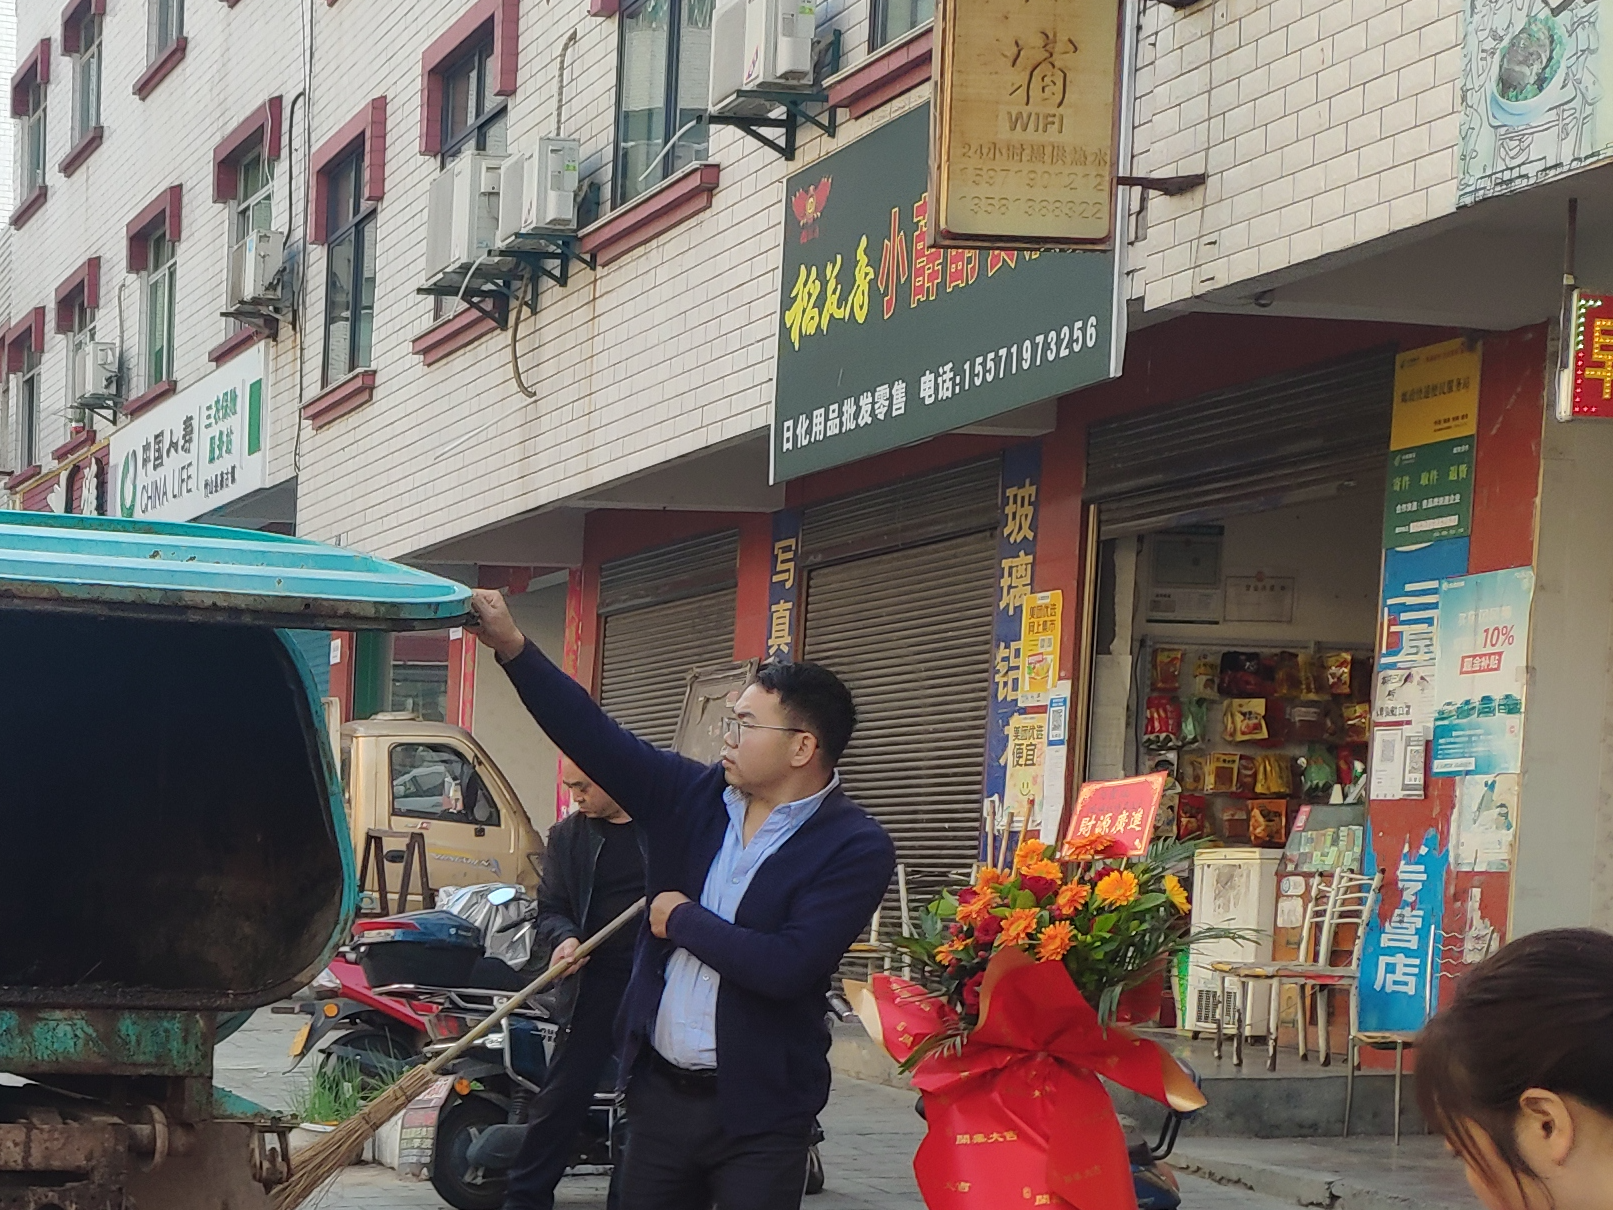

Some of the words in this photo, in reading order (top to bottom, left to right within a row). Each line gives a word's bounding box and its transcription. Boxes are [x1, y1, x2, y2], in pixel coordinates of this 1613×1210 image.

[1006, 110, 1064, 134] WIFI
[961, 141, 1108, 168] 24小时提供热水
[781, 380, 907, 453] 日化用品批发零售
[141, 414, 194, 478] 中国人寿
[140, 474, 169, 514] CHINA
[171, 461, 194, 499] LIFE
[768, 537, 796, 656] 写真
[1482, 624, 1515, 649] 10%
[1012, 724, 1044, 741] 美团优选
